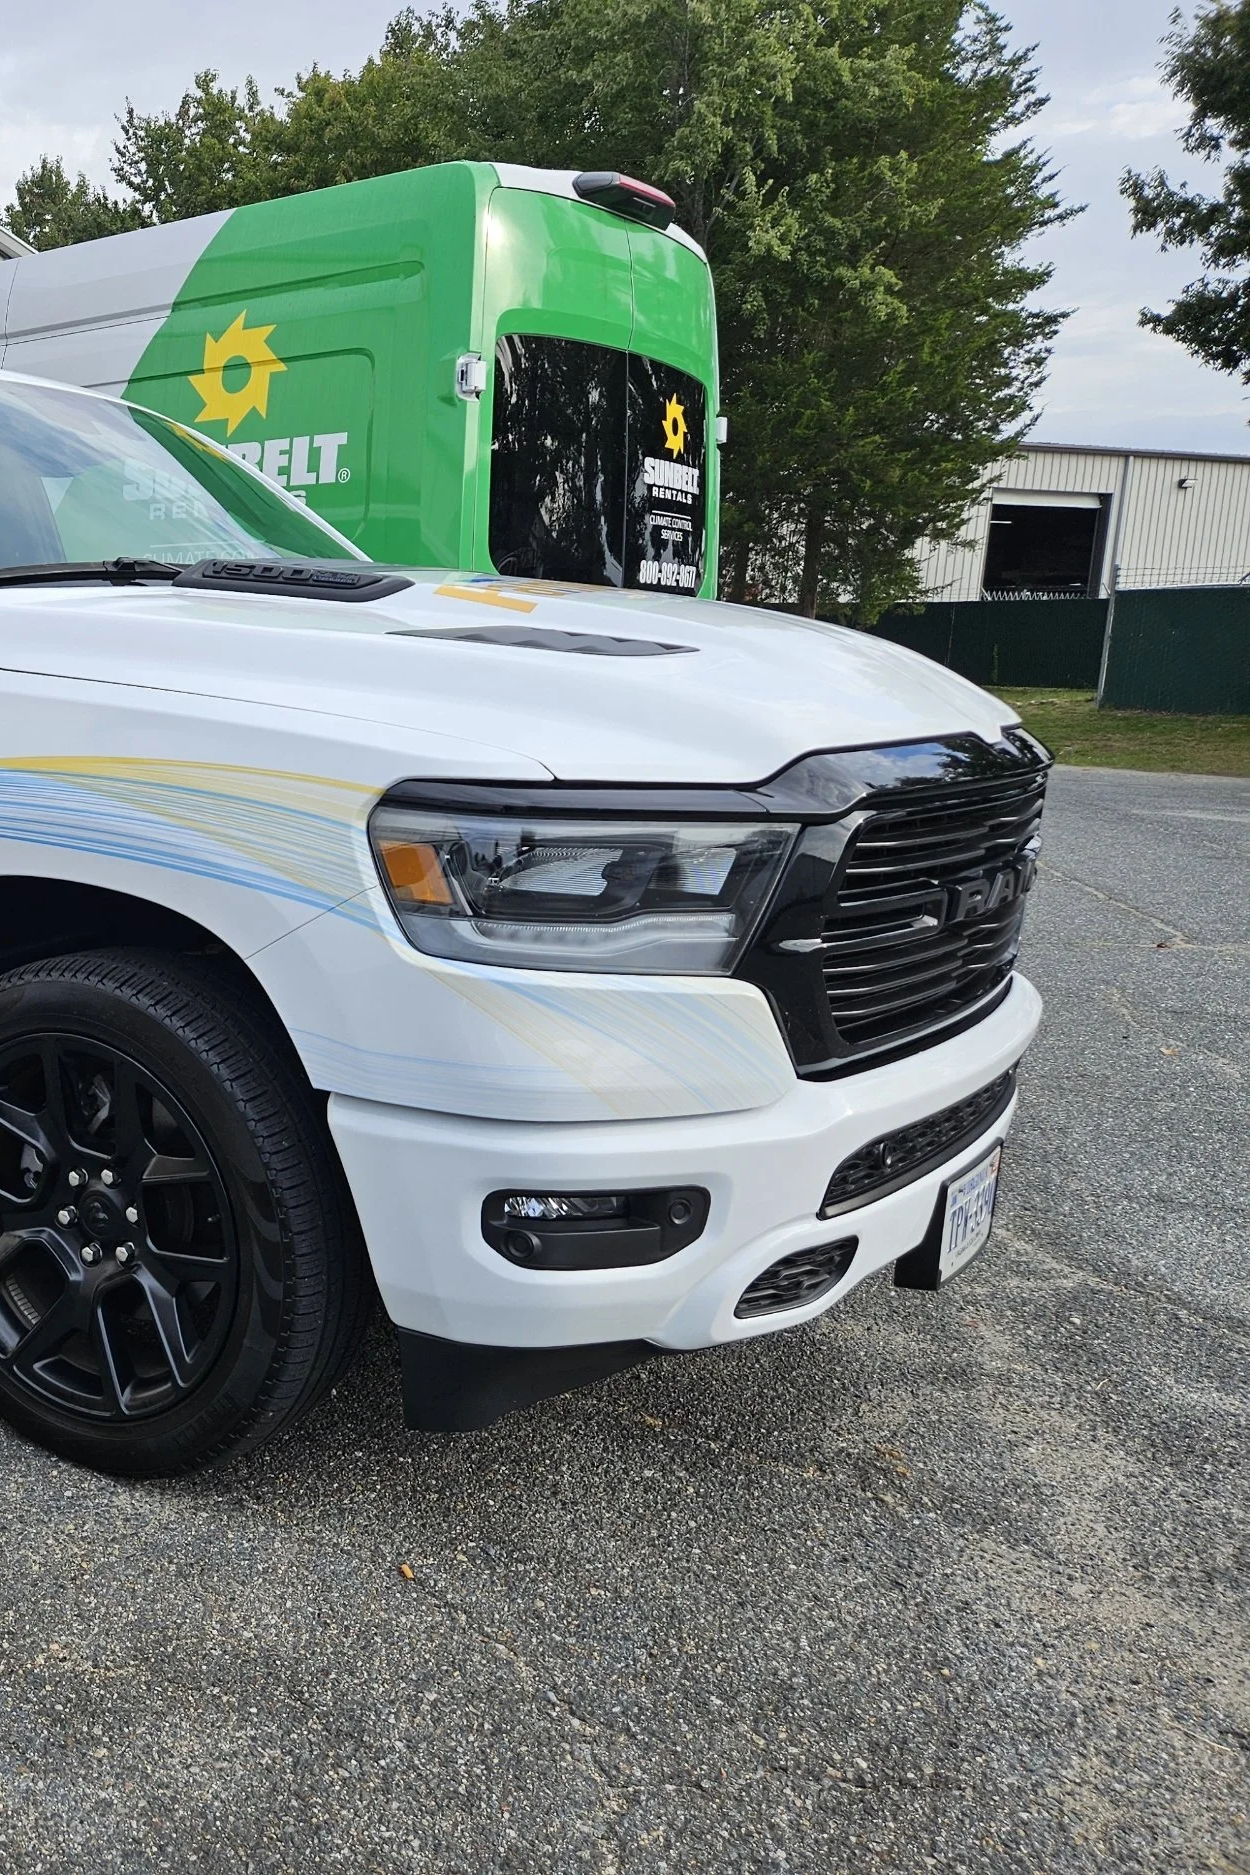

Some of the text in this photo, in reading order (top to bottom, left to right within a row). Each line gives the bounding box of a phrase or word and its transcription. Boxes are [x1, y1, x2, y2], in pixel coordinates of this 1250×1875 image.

[643, 457, 700, 495] SUNBELT
[652, 486, 693, 504] RENTALS
[650, 514, 693, 531] CLIMATE CONTROL
[660, 529, 683, 542] SERVICES
